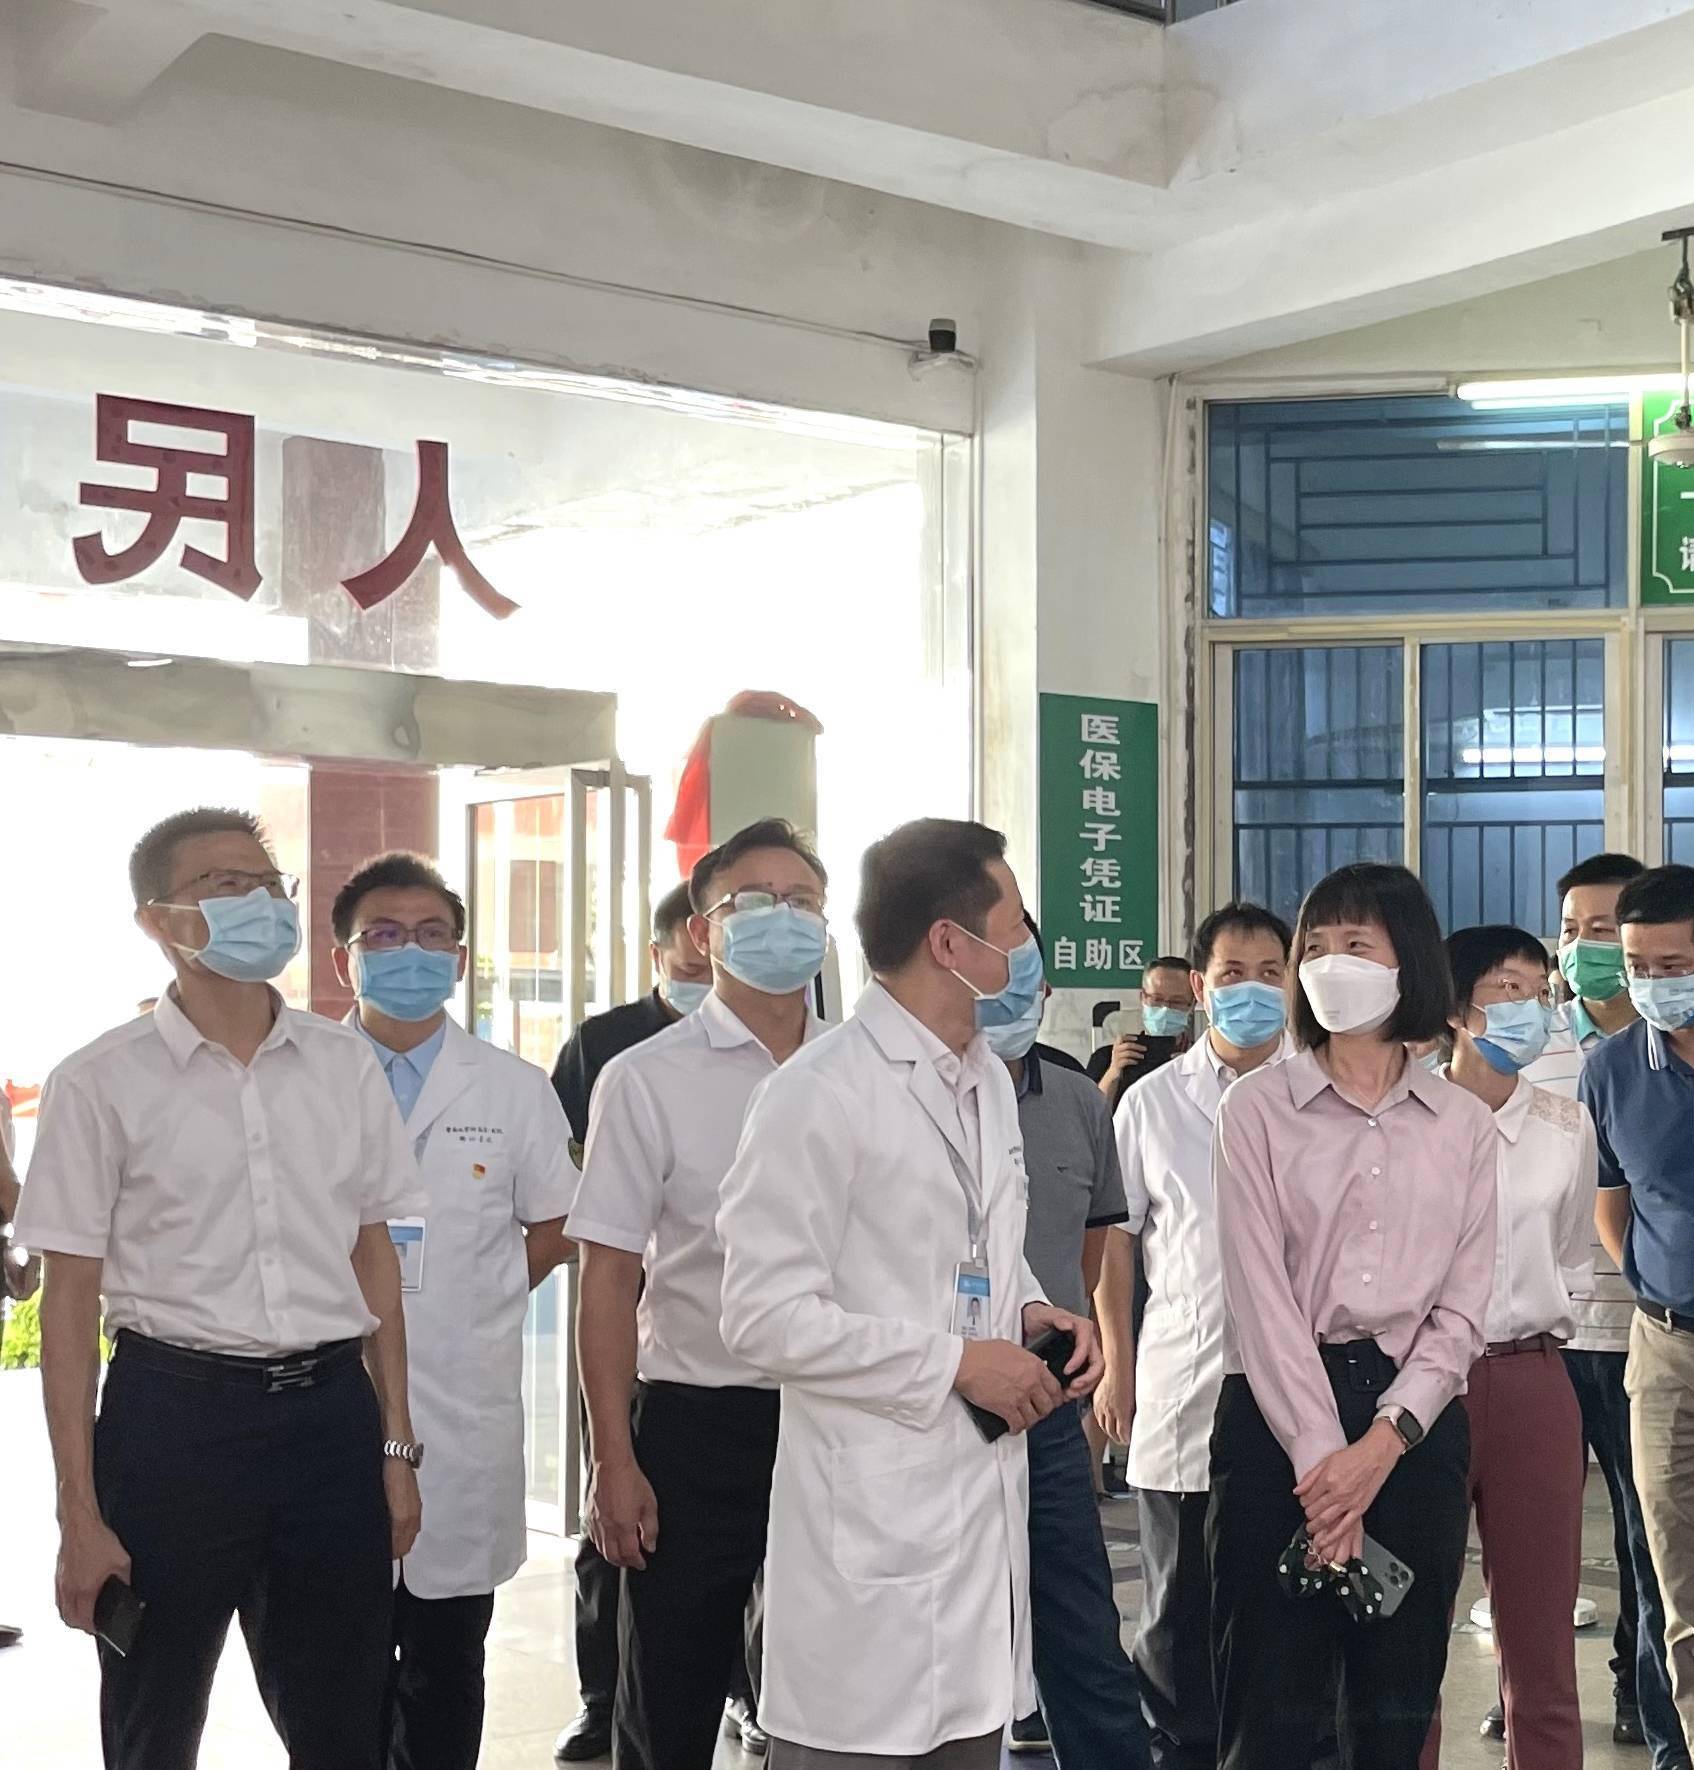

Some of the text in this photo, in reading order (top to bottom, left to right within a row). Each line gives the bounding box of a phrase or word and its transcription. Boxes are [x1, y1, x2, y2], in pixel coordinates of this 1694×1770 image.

[1079, 714, 1122, 923] 医保电子凭证
[1054, 936, 1144, 971] 自助区
